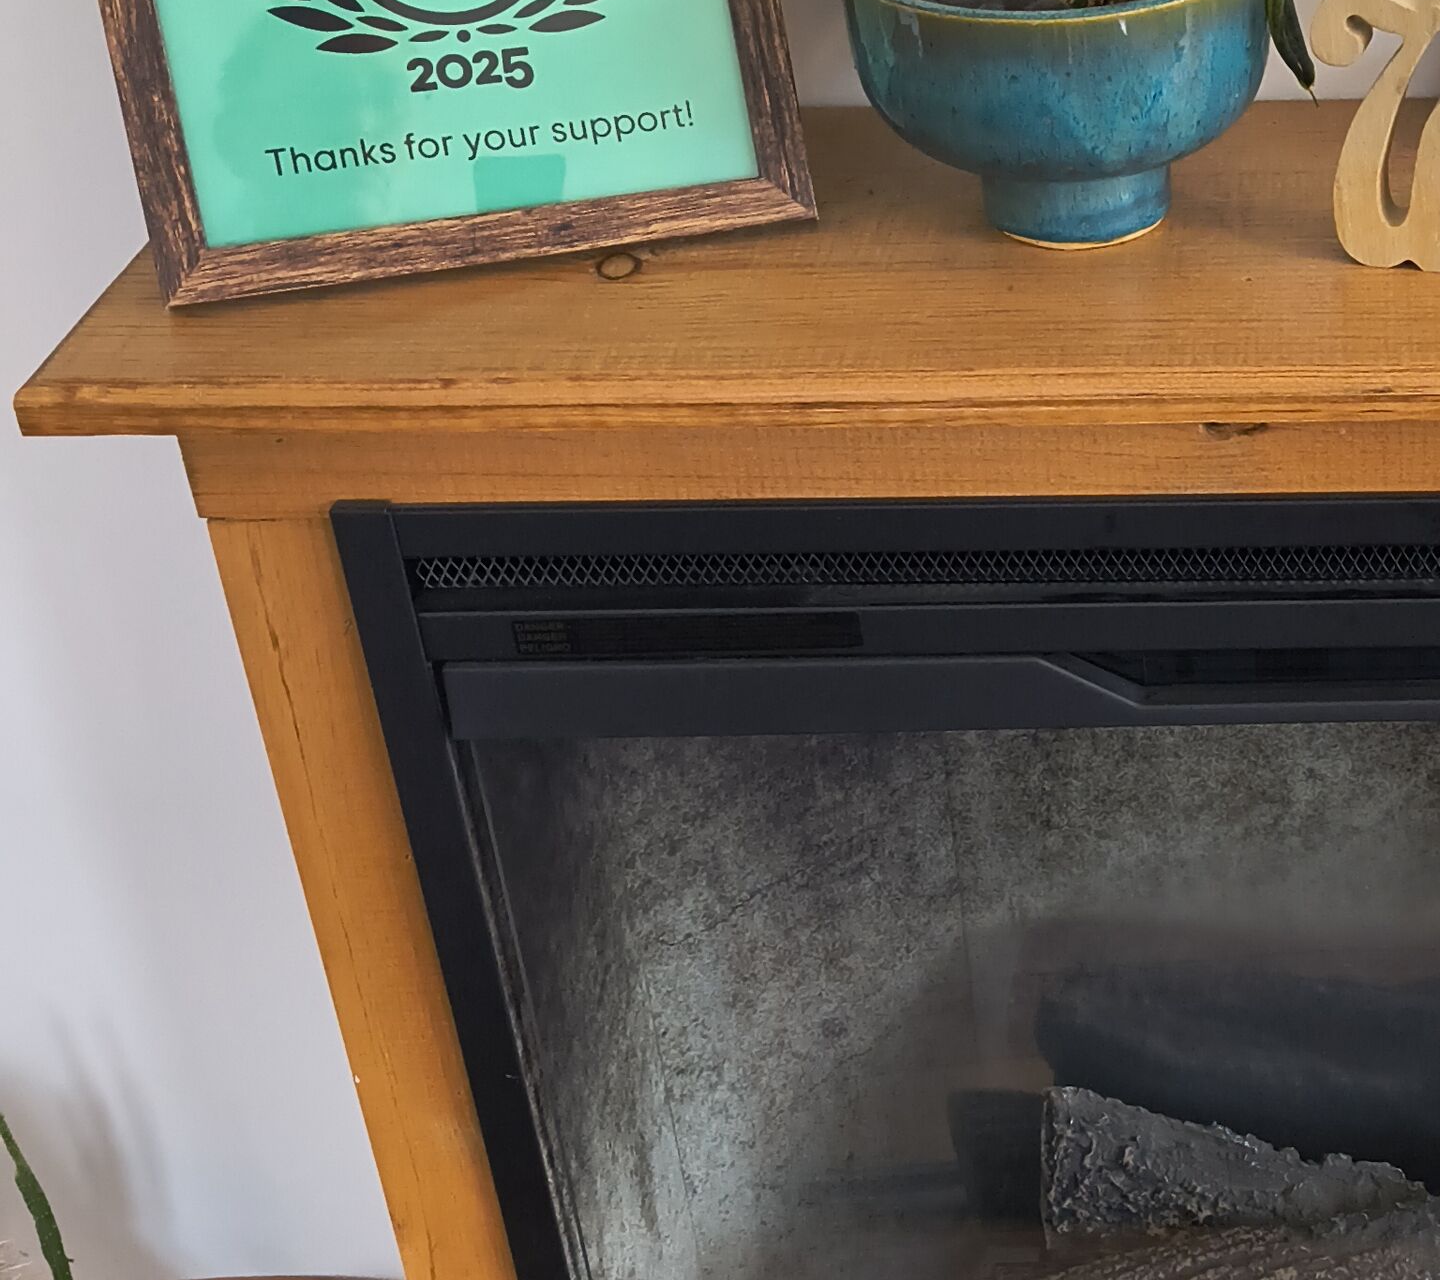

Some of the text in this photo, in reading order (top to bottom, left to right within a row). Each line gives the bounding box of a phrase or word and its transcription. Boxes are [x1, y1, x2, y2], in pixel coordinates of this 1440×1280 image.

[406, 46, 536, 94] 2025
[263, 98, 695, 178] Thanks for your support!
